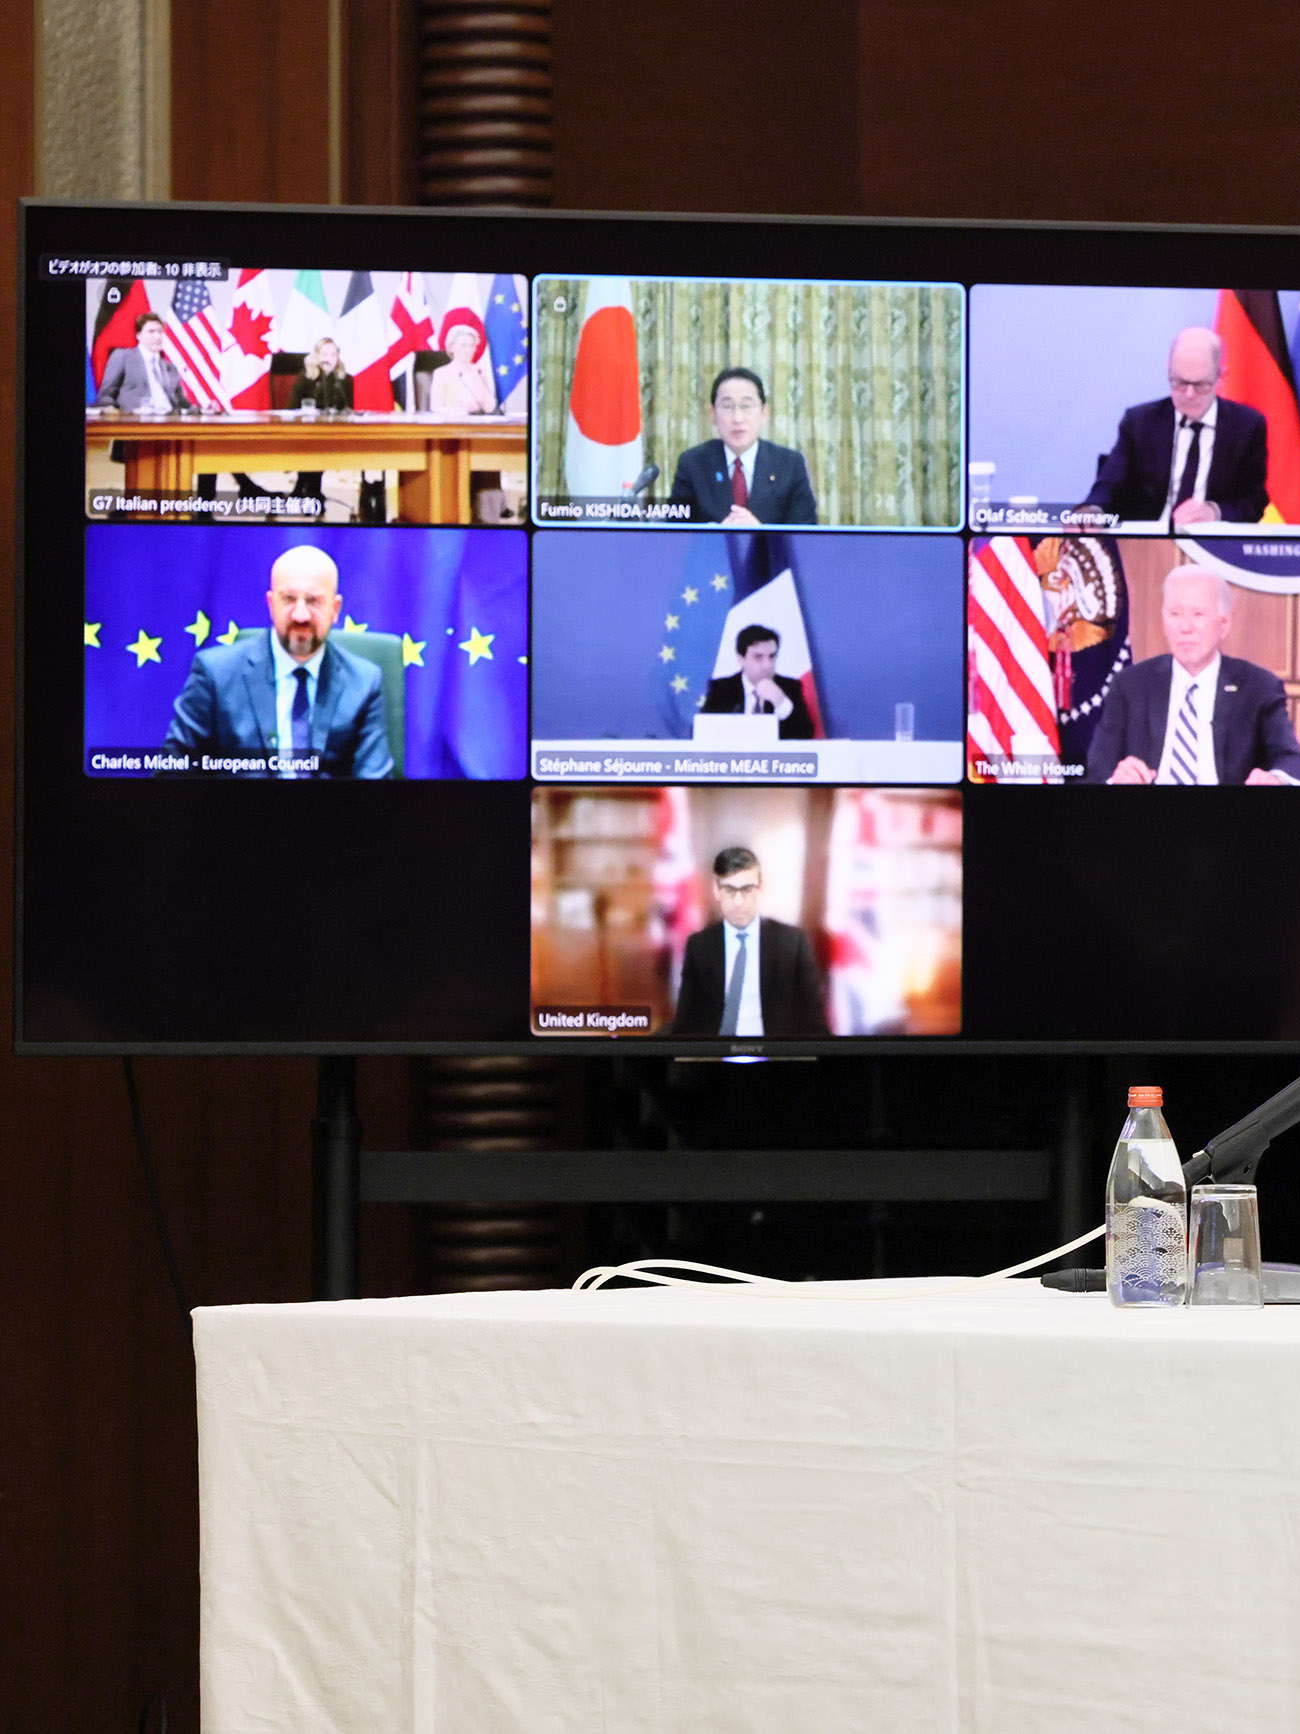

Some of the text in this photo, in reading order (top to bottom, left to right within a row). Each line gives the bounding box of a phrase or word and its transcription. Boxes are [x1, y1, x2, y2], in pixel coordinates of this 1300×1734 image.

[164, 263, 180, 276] 10
[182, 262, 222, 278] 非表示
[92, 496, 322, 515] G7 Italian presidency (共同主催者)
[540, 502, 691, 519] Fumio KISHIDA-JAPAN
[976, 508, 1004, 523] Olaf
[1006, 509, 1049, 524] Scholz
[1059, 509, 1119, 527] Germany
[91, 754, 142, 770] Charles
[143, 754, 190, 770] Michel
[201, 755, 266, 774] European
[268, 756, 319, 771] Council
[539, 757, 601, 775] Stéphane
[674, 758, 728, 774] Ministre
[730, 759, 769, 774] MEAE
[771, 759, 816, 775] France
[975, 760, 1085, 777] The White House
[538, 1011, 649, 1032] United Kingdom
